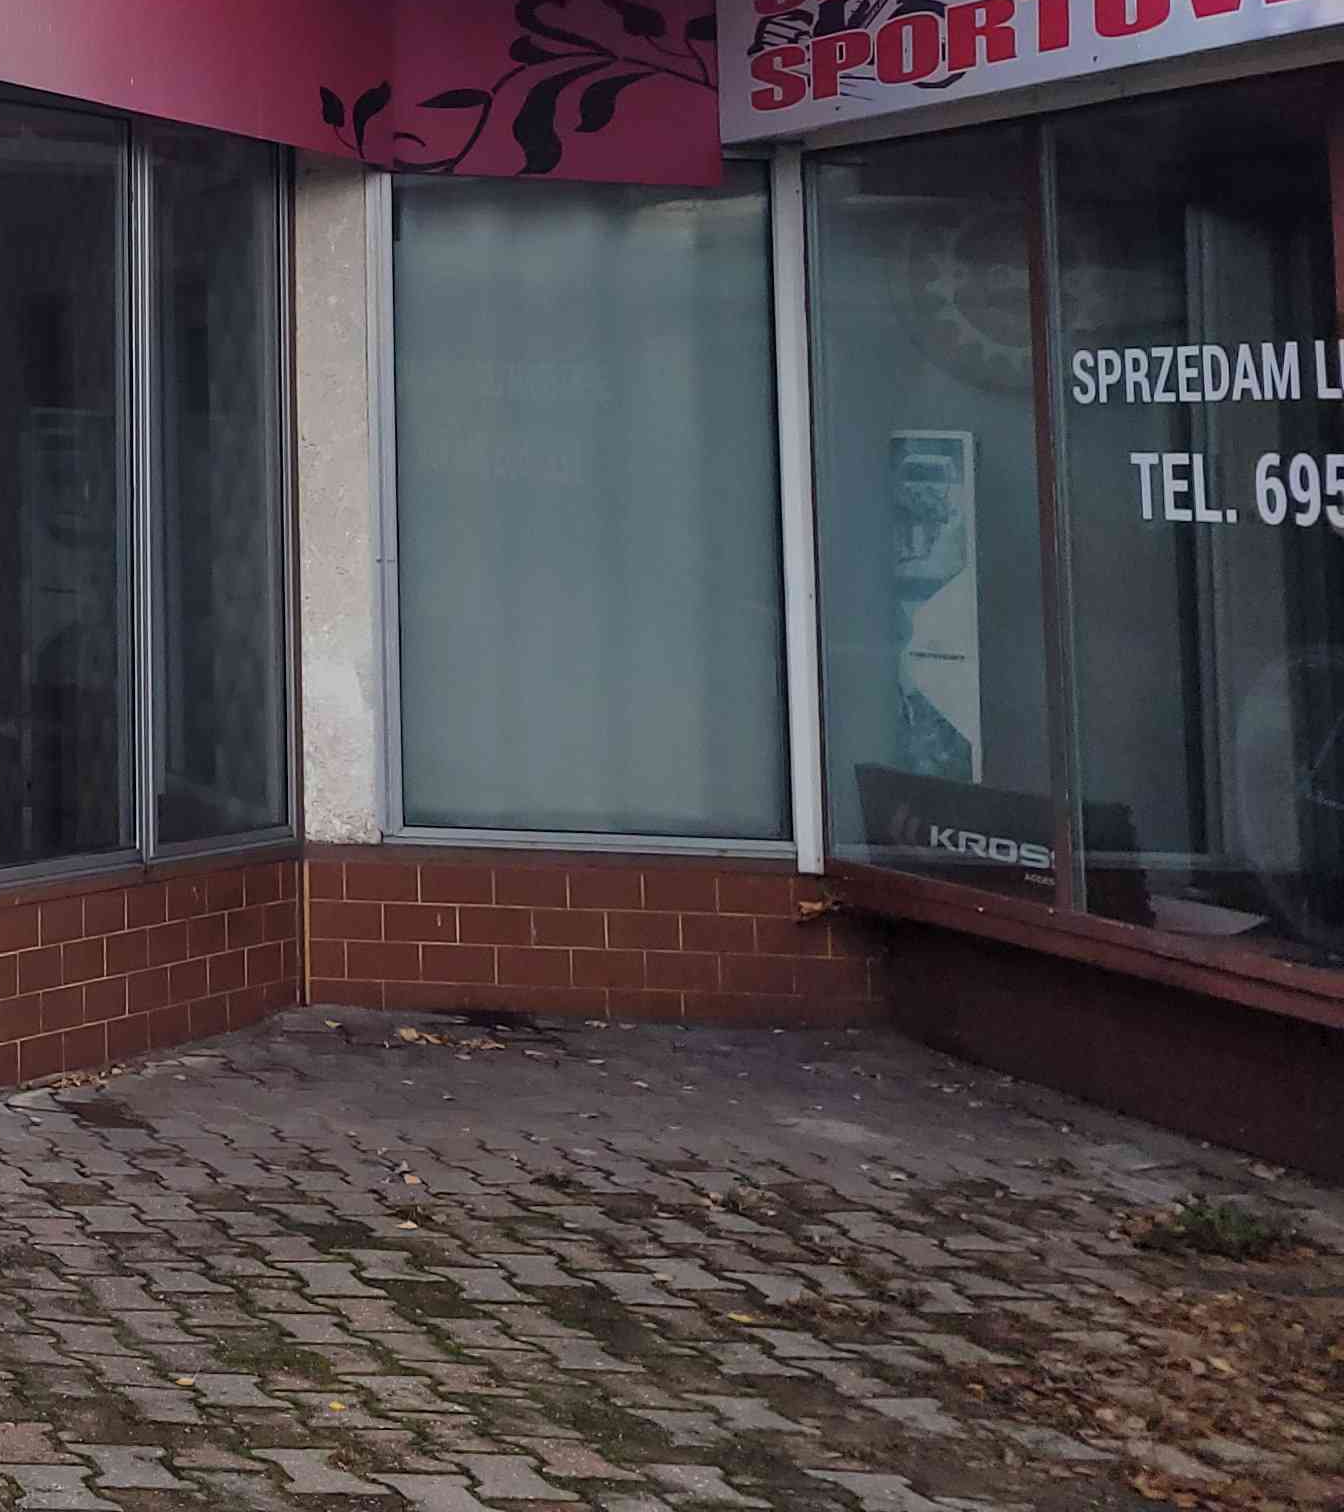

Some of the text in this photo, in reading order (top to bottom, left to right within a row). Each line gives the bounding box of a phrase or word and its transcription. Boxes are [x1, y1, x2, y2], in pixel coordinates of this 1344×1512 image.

[1072, 341, 1301, 403] SPRZEDAM
[1130, 452, 1240, 524] TEL.
[930, 824, 1056, 870] KROS
